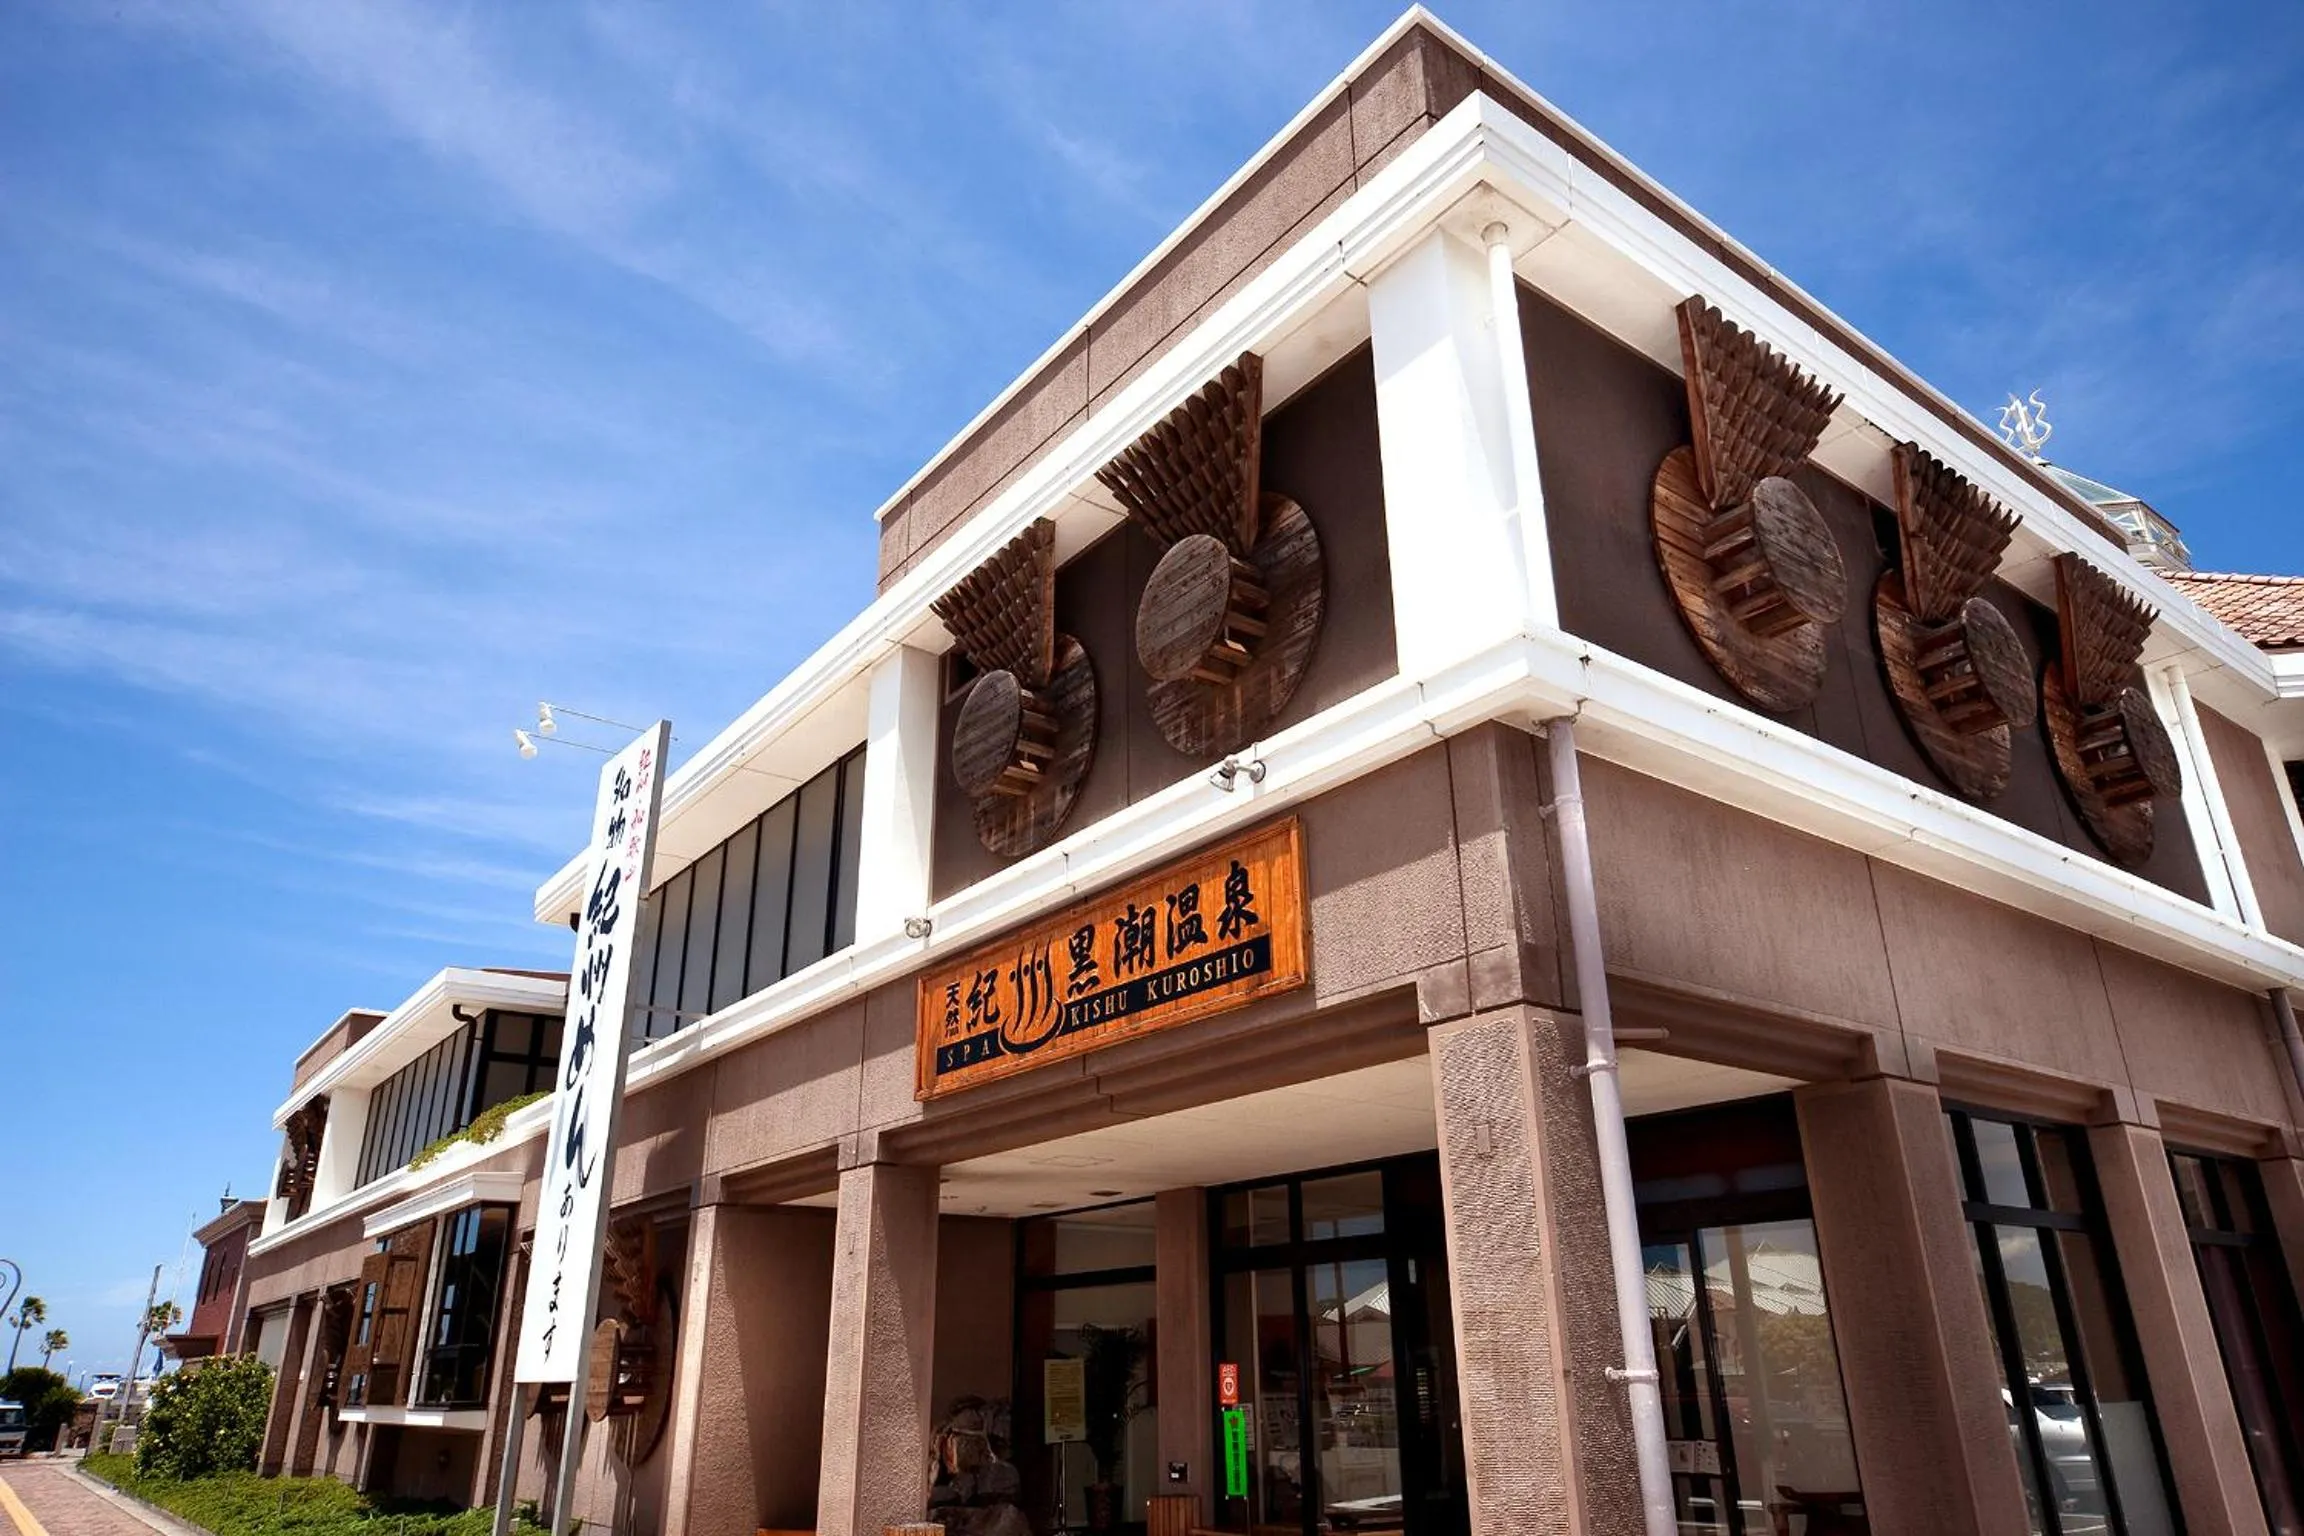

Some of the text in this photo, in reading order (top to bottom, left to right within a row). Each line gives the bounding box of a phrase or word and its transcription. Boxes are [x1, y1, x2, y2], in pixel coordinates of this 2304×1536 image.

[946, 947, 1256, 1068] SPA KISHU KUROSHIO
